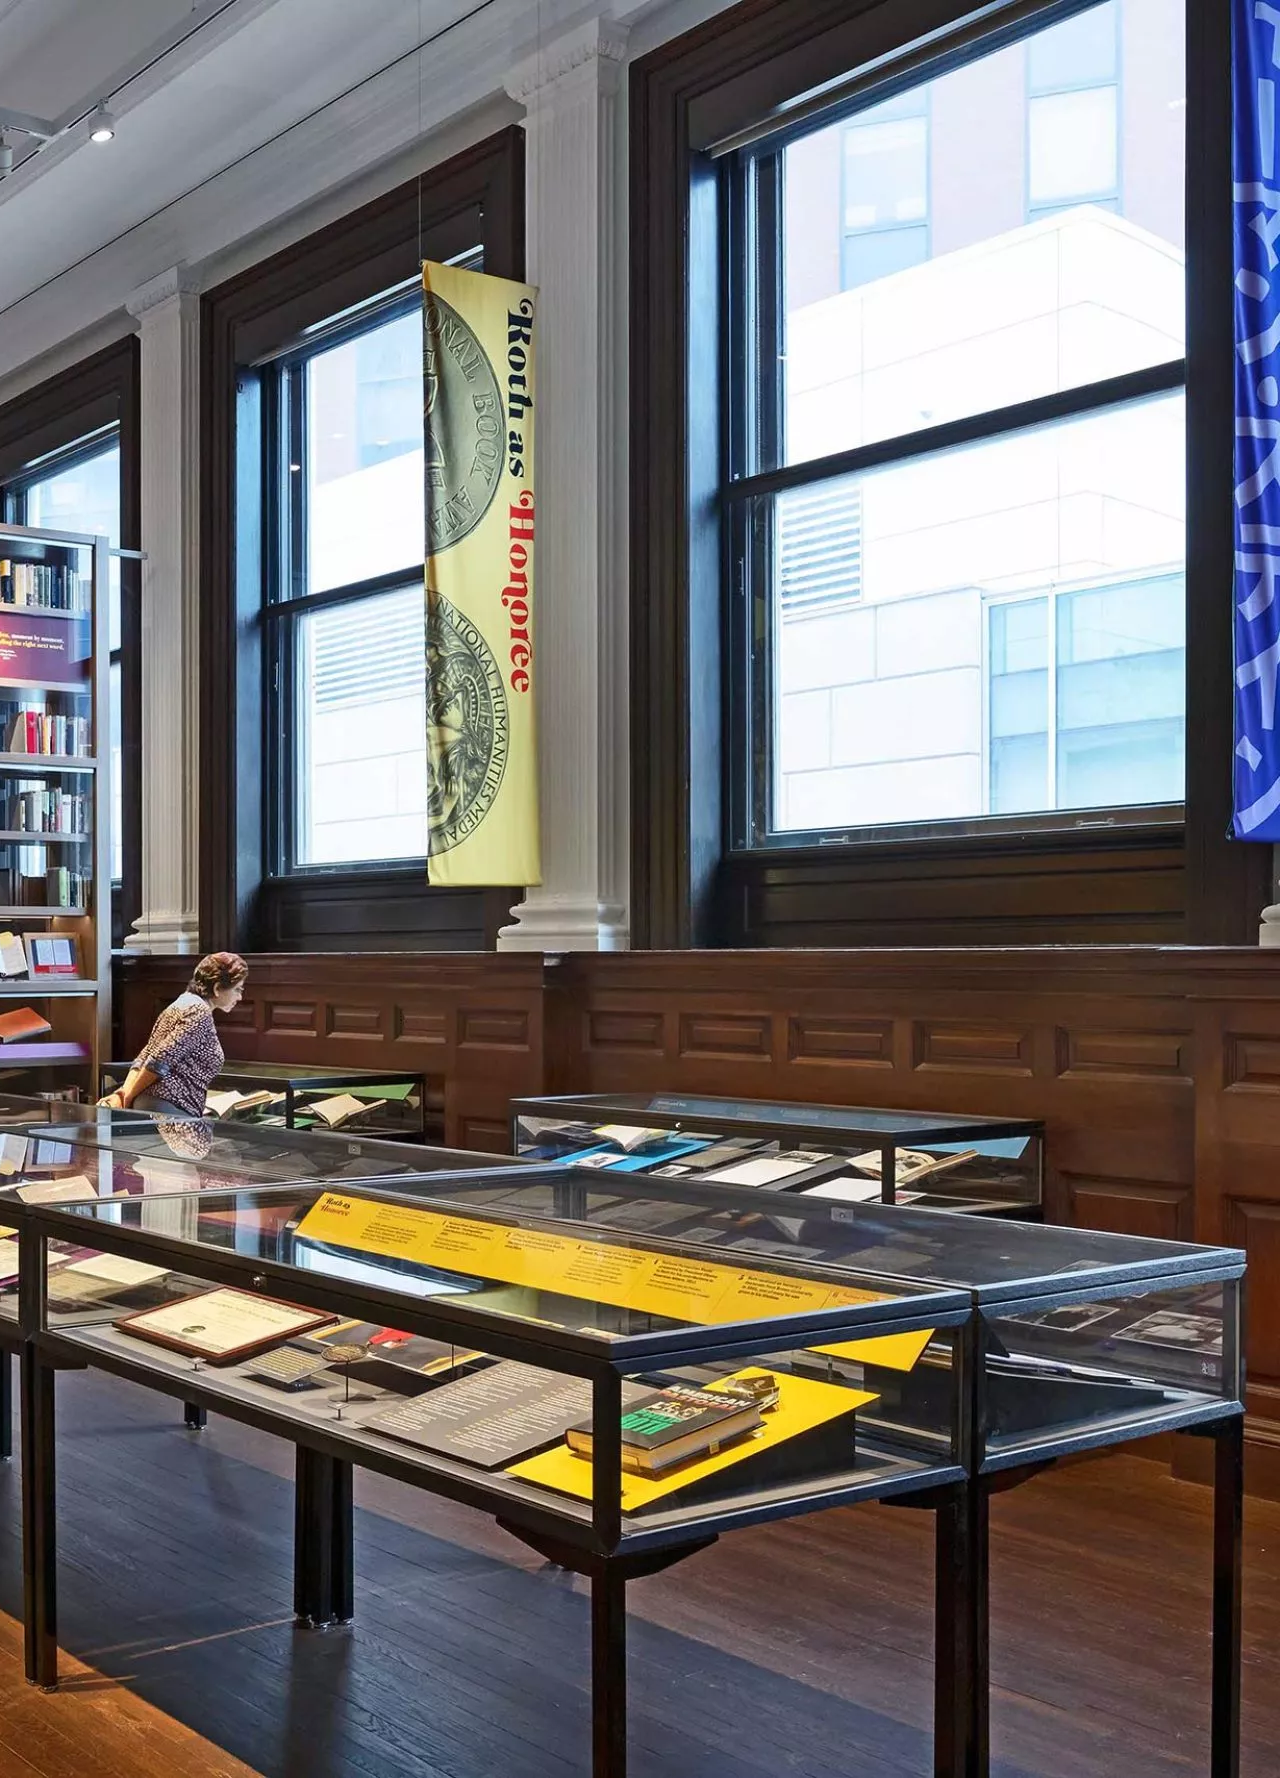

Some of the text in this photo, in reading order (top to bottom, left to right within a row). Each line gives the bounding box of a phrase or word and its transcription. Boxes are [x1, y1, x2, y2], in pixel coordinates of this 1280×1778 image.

[470, 391, 499, 487] BOOK
[501, 298, 535, 693] Roth as Honoree
[435, 596, 509, 847] NATIONAL HUMANITIES MEDAL
[325, 1197, 343, 1207] Roth
[667, 1385, 753, 1407] AMERICAN
